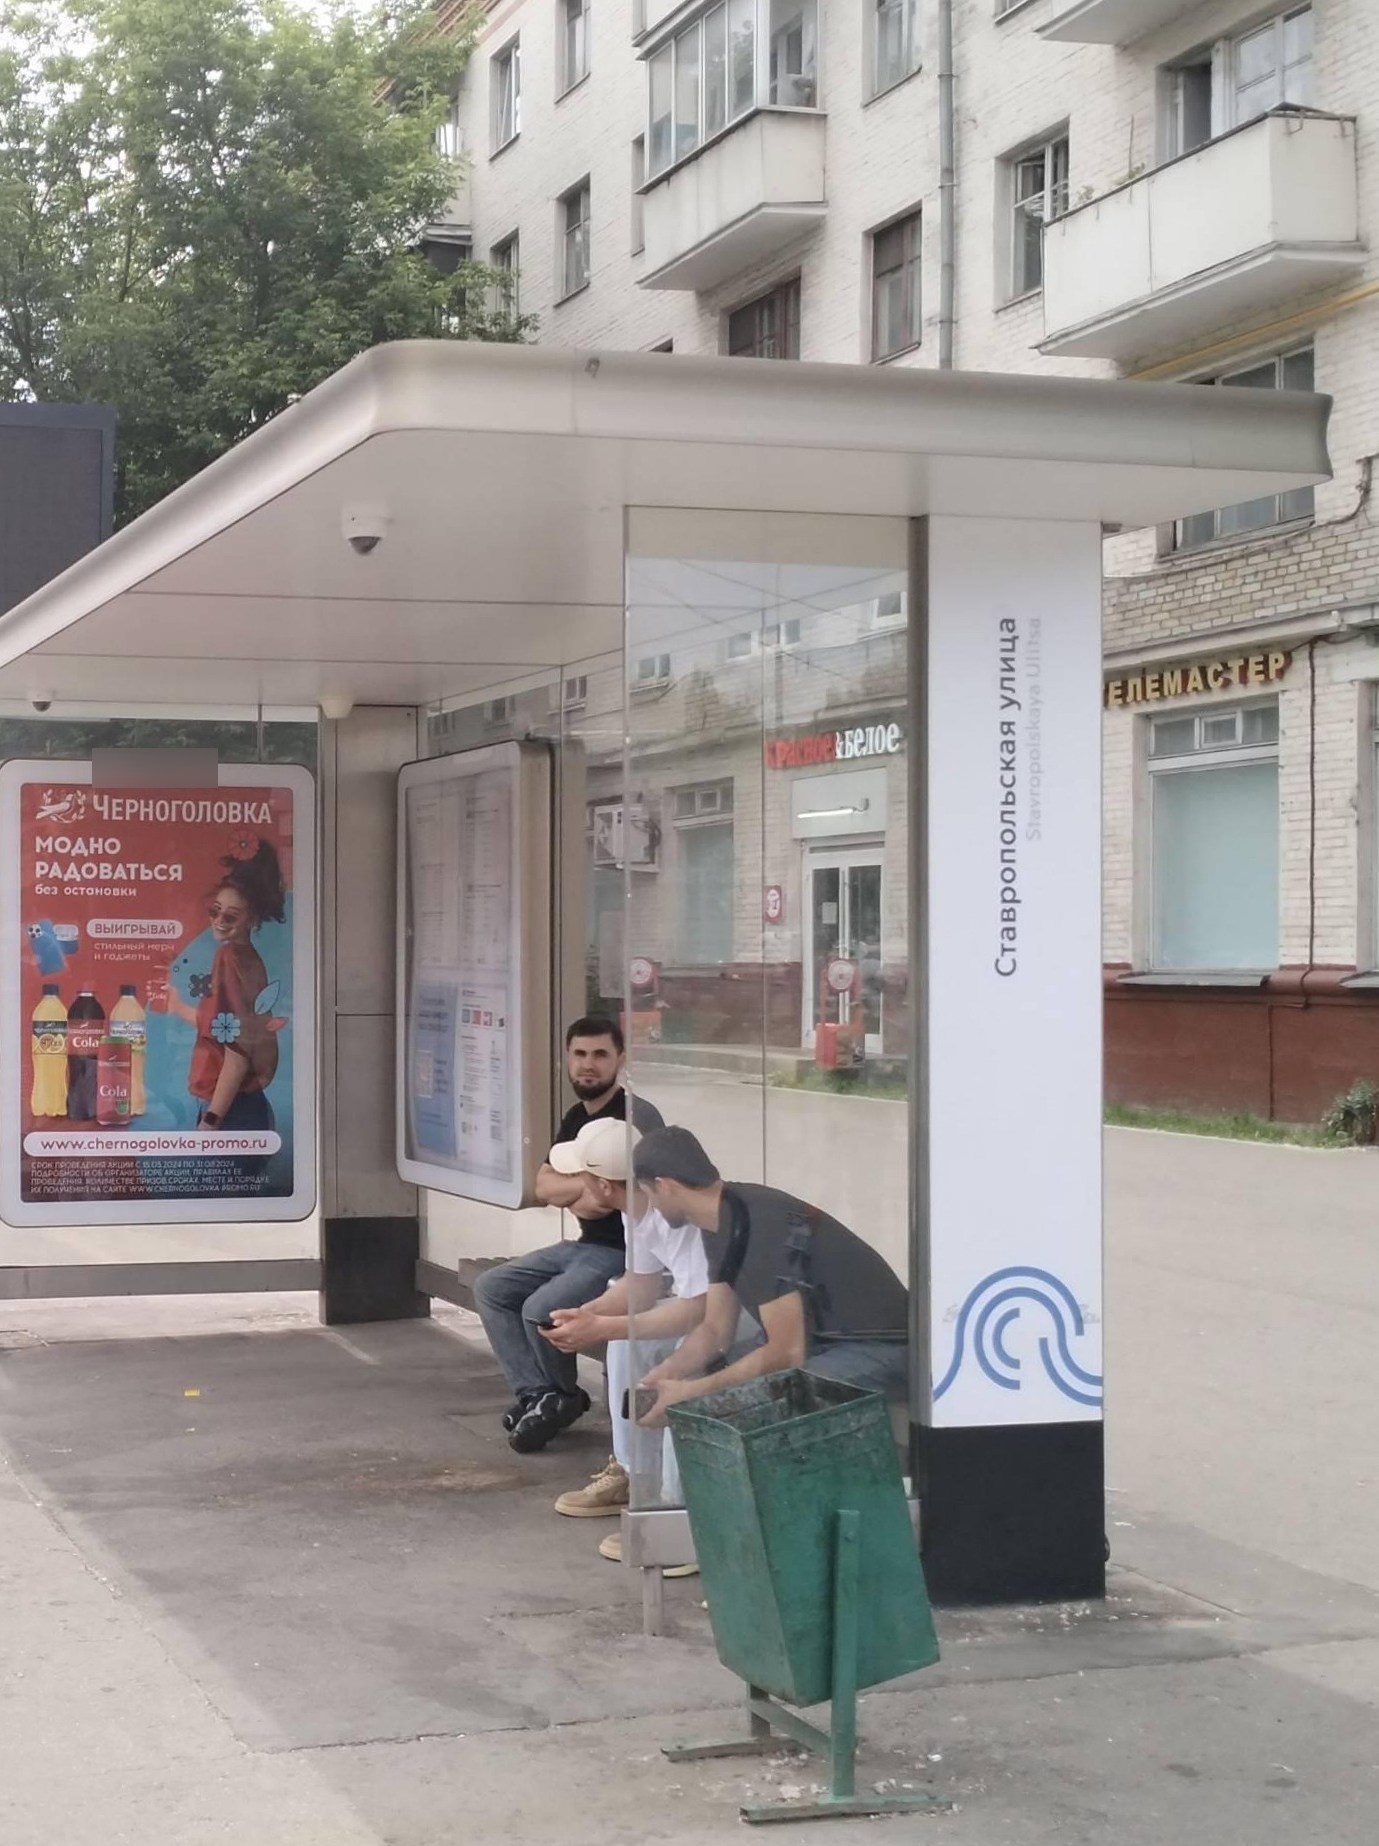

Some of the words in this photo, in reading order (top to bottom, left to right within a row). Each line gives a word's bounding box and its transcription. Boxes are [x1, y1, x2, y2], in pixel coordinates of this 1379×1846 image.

[1026, 617, 1042, 673] Ulitsa
[1000, 617, 1022, 711] улица
[1104, 651, 1292, 708] ЕЛЕМАСТЕР
[1026, 684, 1042, 842] Stavropolskaya
[35, 836, 121, 857] МОДНО
[995, 720, 1021, 977] Ставропольская
[35, 861, 183, 882] РАДОВАТЬСЯ
[35, 884, 58, 896] без
[64, 886, 137, 897] остановки
[95, 922, 176, 935] ВЫИГРЫВАЙ
[94, 942, 145, 951] стильный
[94, 953, 101, 961] и
[104, 953, 151, 961] гаджеты
[72, 1036, 99, 1048] Cola
[99, 1084, 127, 1097] Cola
[41, 1136, 268, 1152] www.chernogolovka-promo.ru
